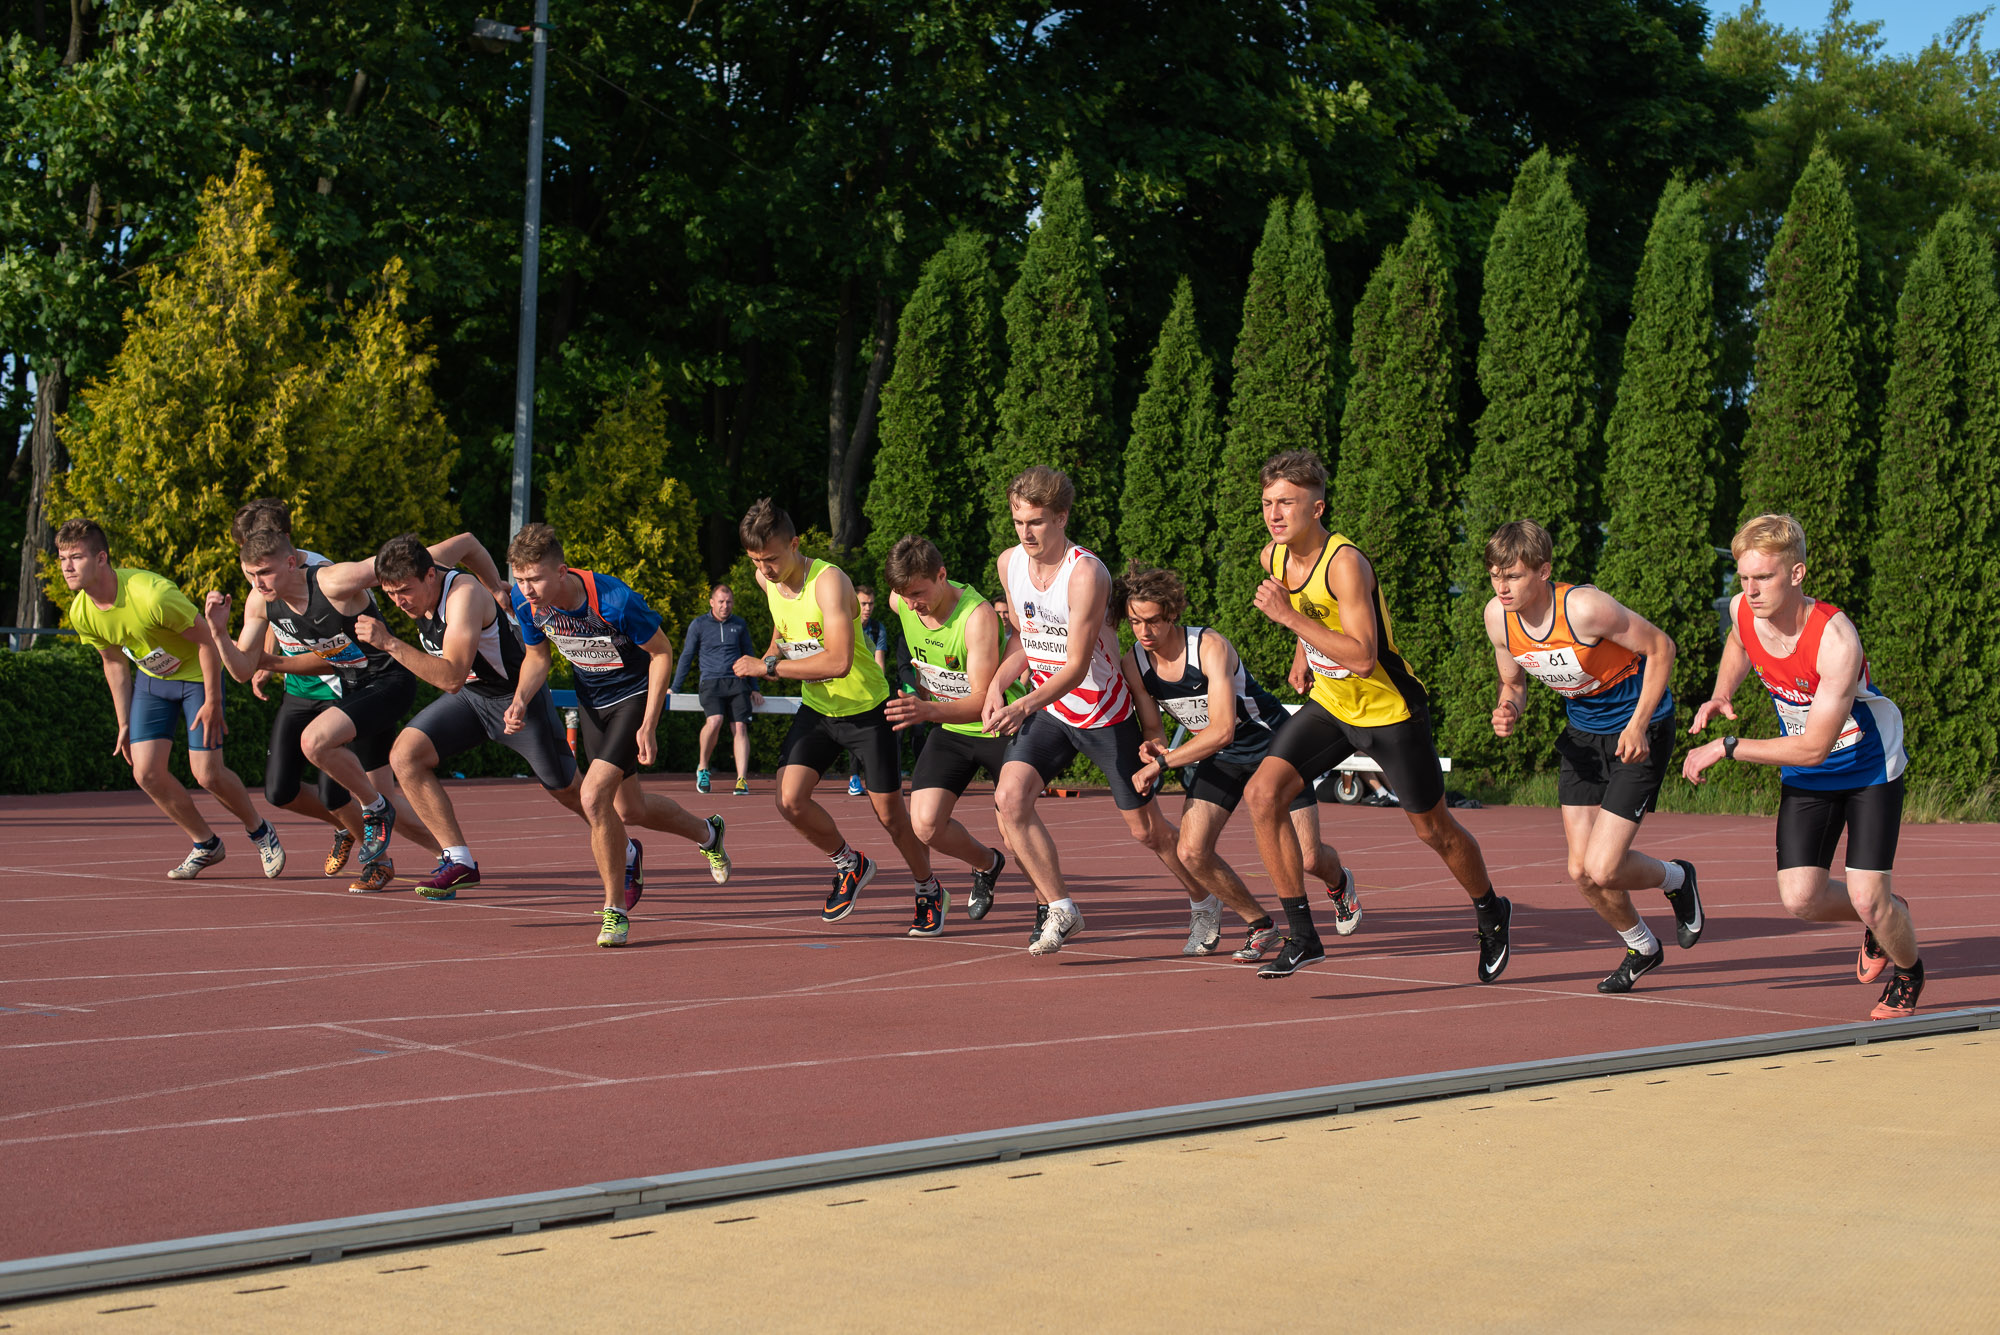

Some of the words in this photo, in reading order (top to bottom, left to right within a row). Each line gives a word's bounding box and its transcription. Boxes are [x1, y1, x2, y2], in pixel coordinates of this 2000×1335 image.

[322, 637, 346, 649] 476
[578, 639, 608, 648] 725
[794, 642, 818, 652] 496
[914, 646, 929, 664] 15
[1549, 652, 1568, 667] 61
